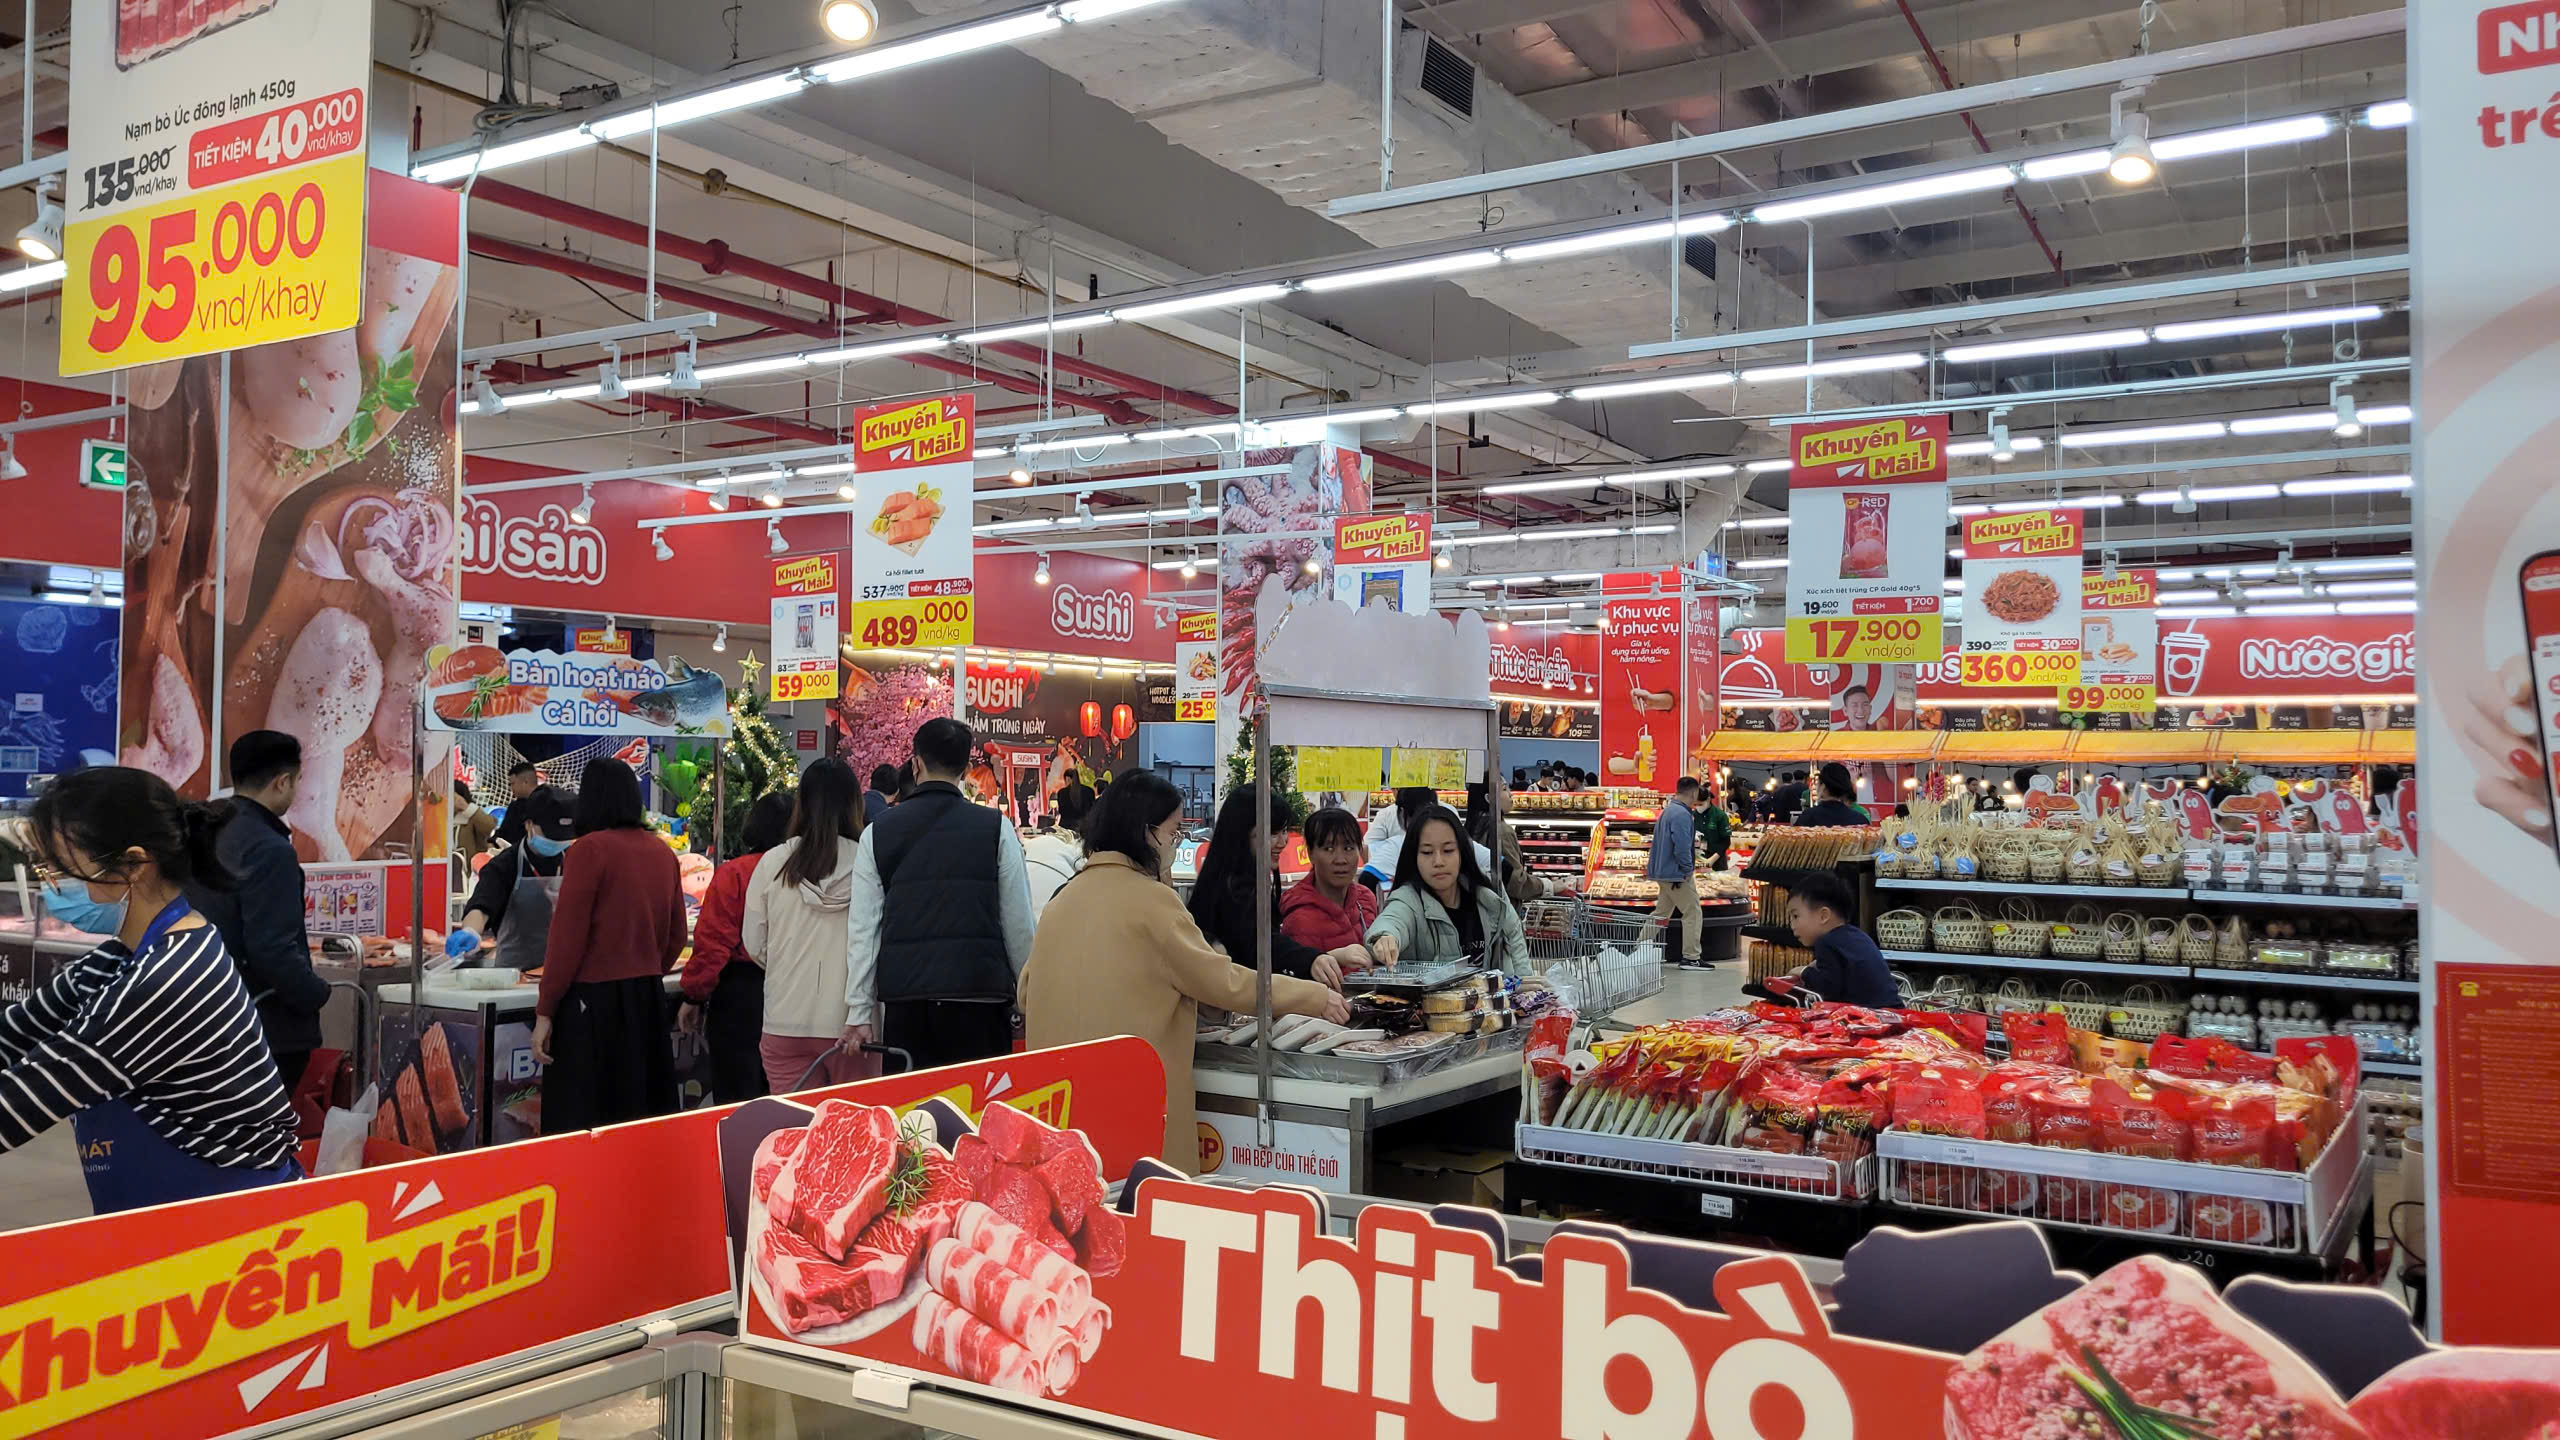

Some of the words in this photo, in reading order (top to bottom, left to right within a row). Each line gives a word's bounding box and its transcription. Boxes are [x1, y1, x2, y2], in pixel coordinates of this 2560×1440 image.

[125, 122, 151, 142] Nạm
[155, 115, 171, 132] bò
[173, 104, 190, 127] Úc
[193, 98, 226, 121] đông
[229, 88, 256, 113] lạnh
[260, 79, 296, 102] 450g
[194, 141, 220, 169] TIẾT
[221, 136, 252, 164] KIỆM
[255, 94, 358, 164] 40.000
[307, 129, 354, 153] vnd/khay
[84, 148, 171, 209] 135.000
[134, 175, 178, 198] vnd/khay
[88, 182, 326, 353] 95.000
[197, 276, 327, 332] vnd/khay
[865, 408, 937, 443] Khuyến
[919, 422, 961, 459] Mãi!
[1805, 427, 1899, 459] Khuyến
[1875, 441, 1931, 477] Mãi!
[1344, 521, 1401, 544] Khuyến
[1974, 516, 2046, 539] Khuyến
[2028, 527, 2069, 551] Mãi!
[507, 514, 597, 575] sản
[1387, 532, 1422, 556] Mãi!
[778, 562, 818, 581] Khuyến
[807, 570, 831, 590] Mãi!
[1806, 587, 1819, 595] Xúc
[1820, 586, 1835, 594] xích
[1881, 584, 1897, 592] Gold
[1057, 592, 1129, 634] Sushi
[1613, 605, 1640, 619] Khu
[1644, 605, 1671, 621] vực
[1804, 601, 1839, 615] 19.600
[1905, 597, 1934, 612] 1.700
[862, 601, 968, 647] 489.000
[924, 626, 960, 640] vnd/kg
[1623, 621, 1658, 638] phục
[1661, 621, 1680, 636] vụ
[1809, 619, 1921, 658] 17.900
[1864, 645, 1915, 659] vnd/gói
[2041, 639, 2078, 650] 30.000
[1491, 649, 1526, 679] Thức
[1964, 655, 2076, 683] 360.000
[2248, 641, 2356, 673] Nước
[510, 660, 559, 687] Bàn
[563, 662, 623, 693] hoạt
[626, 668, 666, 691] náo
[777, 674, 830, 698] 59.000
[2066, 687, 2145, 709] 99.000
[542, 700, 576, 727] Cá
[579, 700, 618, 728] hồi
[991, 718, 1020, 734] TRONG
[1022, 717, 1046, 735] NGÀY
[1232, 1144, 1251, 1166] NHÀ
[1253, 1146, 1273, 1168] BẾP
[1275, 1147, 1295, 1172] CỦA
[1297, 1150, 1317, 1175] THẾ
[1319, 1155, 1339, 1178] GIỚI
[369, 1198, 546, 1330] Mãi!
[1151, 1199, 1499, 1440] Thịt
[1561, 1258, 1854, 1440] bò
